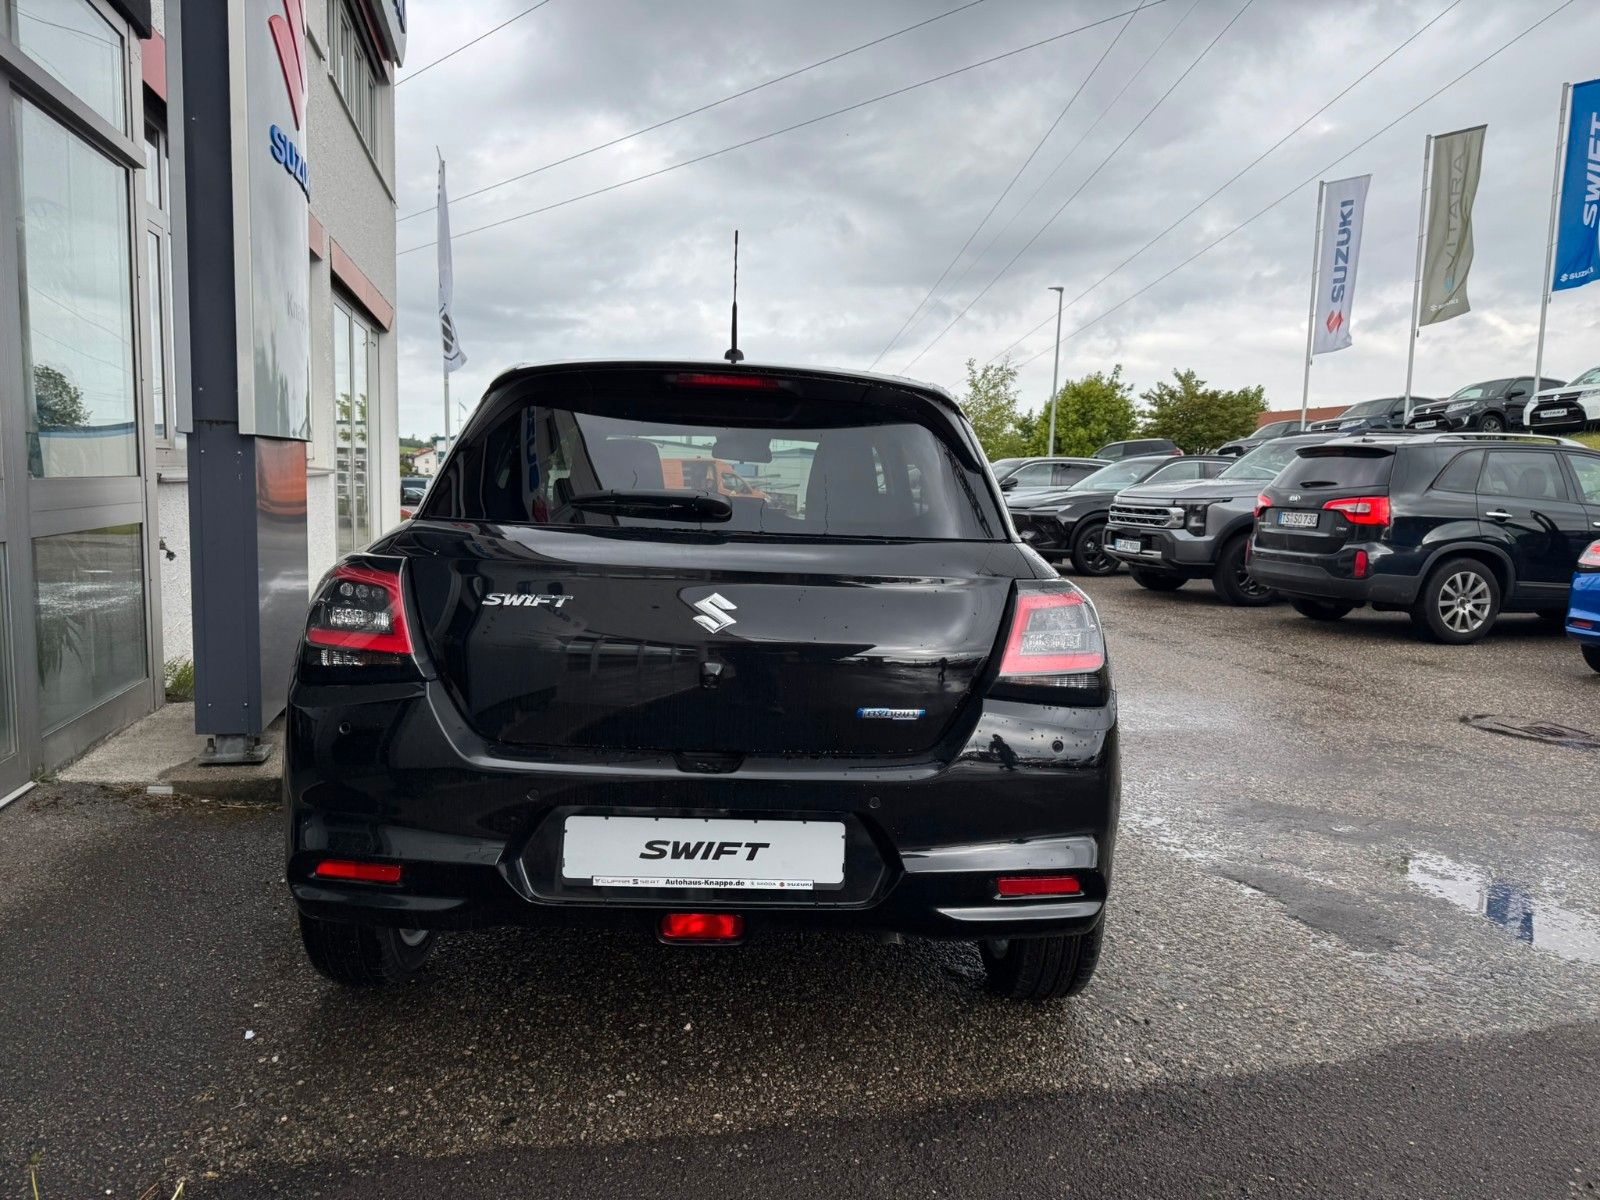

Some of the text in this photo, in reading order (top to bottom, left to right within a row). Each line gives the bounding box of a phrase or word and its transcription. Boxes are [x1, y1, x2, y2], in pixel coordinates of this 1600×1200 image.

[1583, 111, 1600, 228] SWIFT
[1331, 199, 1354, 303] SUZUKI
[482, 592, 574, 608] SWIFT
[639, 839, 771, 861] SWIFT
[665, 878, 745, 888] Autohaus-Knappe.de
